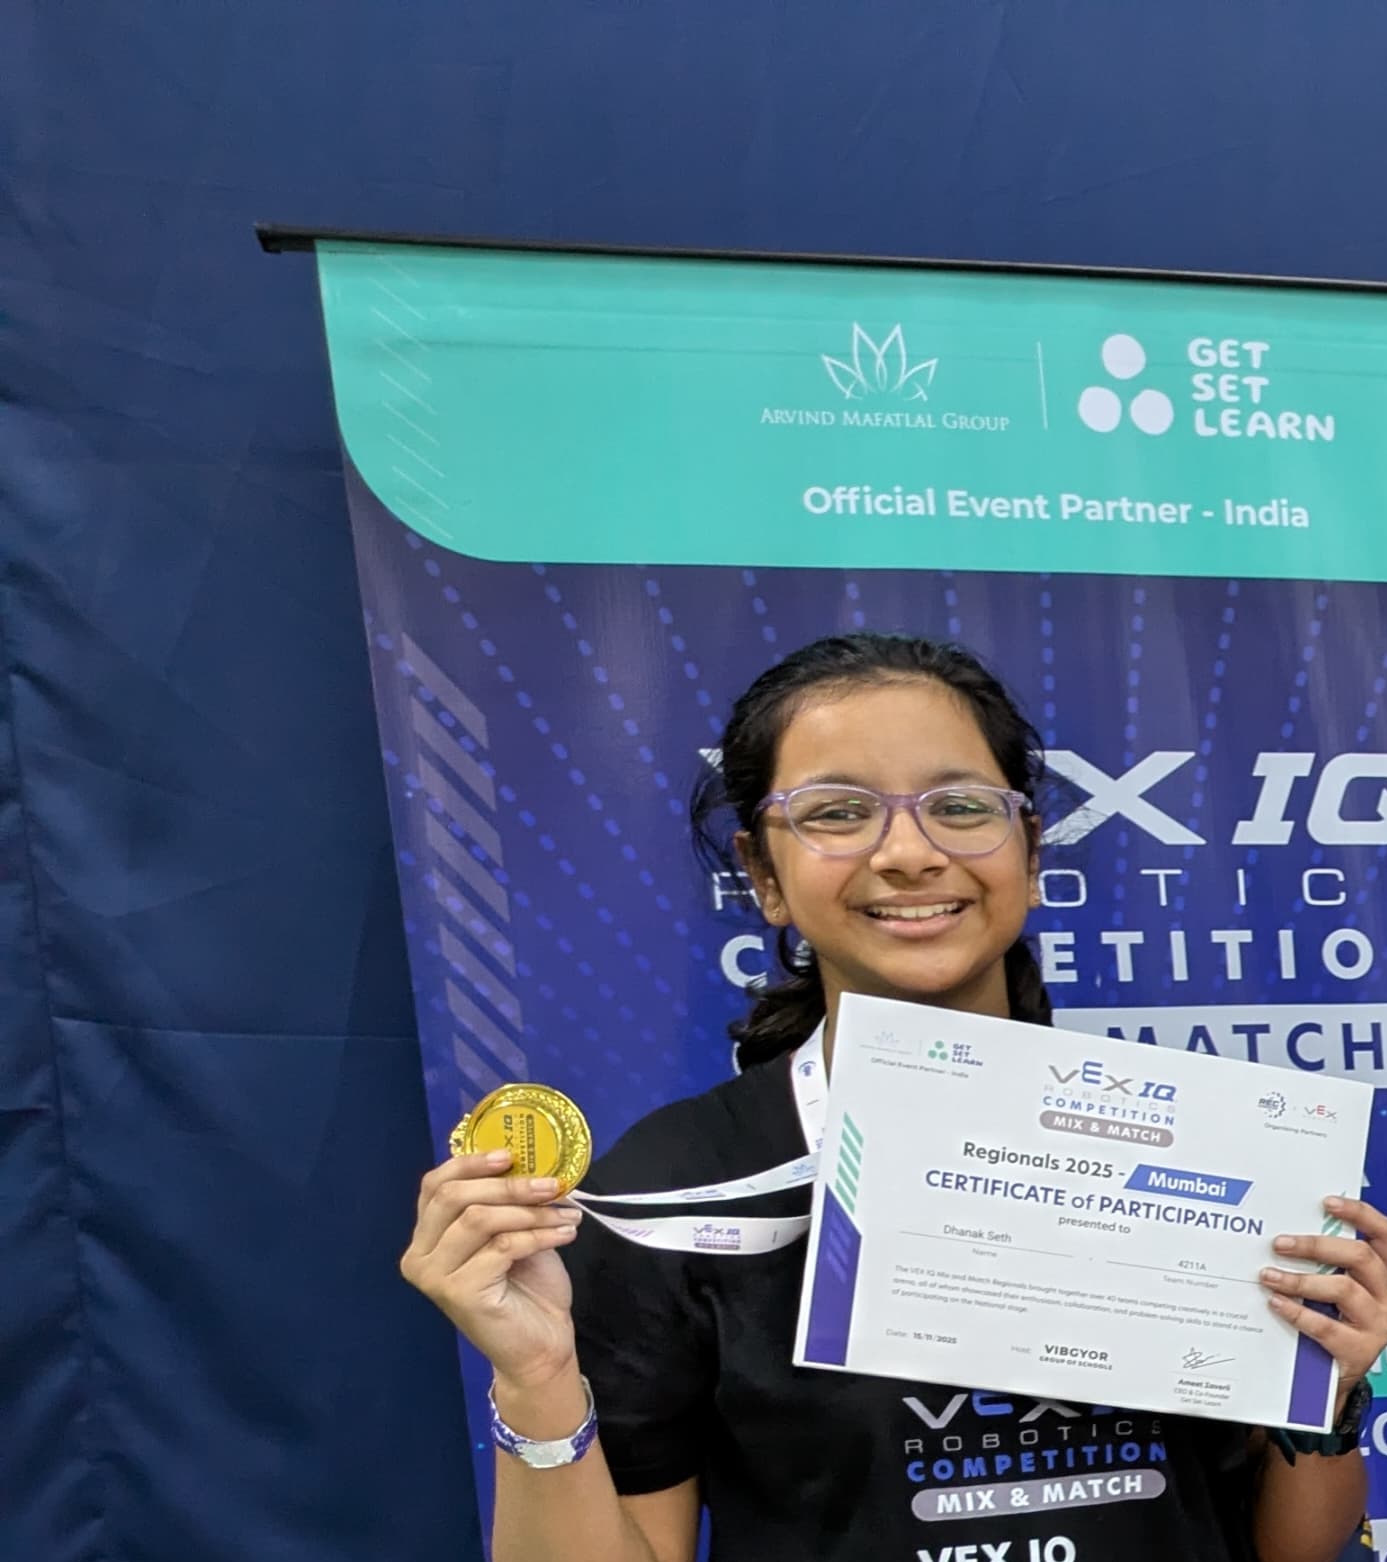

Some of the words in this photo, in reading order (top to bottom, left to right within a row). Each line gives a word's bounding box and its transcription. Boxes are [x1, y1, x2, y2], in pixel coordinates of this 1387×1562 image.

[1188, 338, 1270, 369] GET
[1191, 374, 1269, 404] SET
[1194, 408, 1335, 441] LEARN
[803, 487, 936, 517] Official
[947, 490, 1051, 520] Event
[1060, 493, 1192, 524] Partner
[1225, 498, 1309, 527] India
[1138, 1082, 1177, 1102] IQ
[1043, 1095, 1175, 1126] COMPETITION
[1054, 1115, 1083, 1130] MIX
[1090, 1122, 1100, 1132] &
[1106, 1124, 1161, 1143] MATCH
[963, 1141, 1060, 1171] Regionals
[1065, 1158, 1114, 1179] 2025
[1147, 1171, 1228, 1198] Mumbai
[925, 1169, 1067, 1207] CERTIFICATE
[1071, 1193, 1095, 1211] of
[1098, 1196, 1264, 1237] PARTICIPATION
[943, 1224, 985, 1241] Dhanak
[987, 1231, 1013, 1245] Seth
[1058, 1214, 1117, 1234] presented
[1119, 1224, 1132, 1235] to
[1177, 1259, 1208, 1272] 4211A
[1044, 1343, 1110, 1363] VIBGYOR
[904, 1420, 1162, 1455] ROBOTICS
[906, 1442, 1167, 1483] COMPETITION
[937, 1489, 997, 1515] MIX
[1010, 1486, 1030, 1508] &
[1042, 1474, 1144, 1504] MATCH
